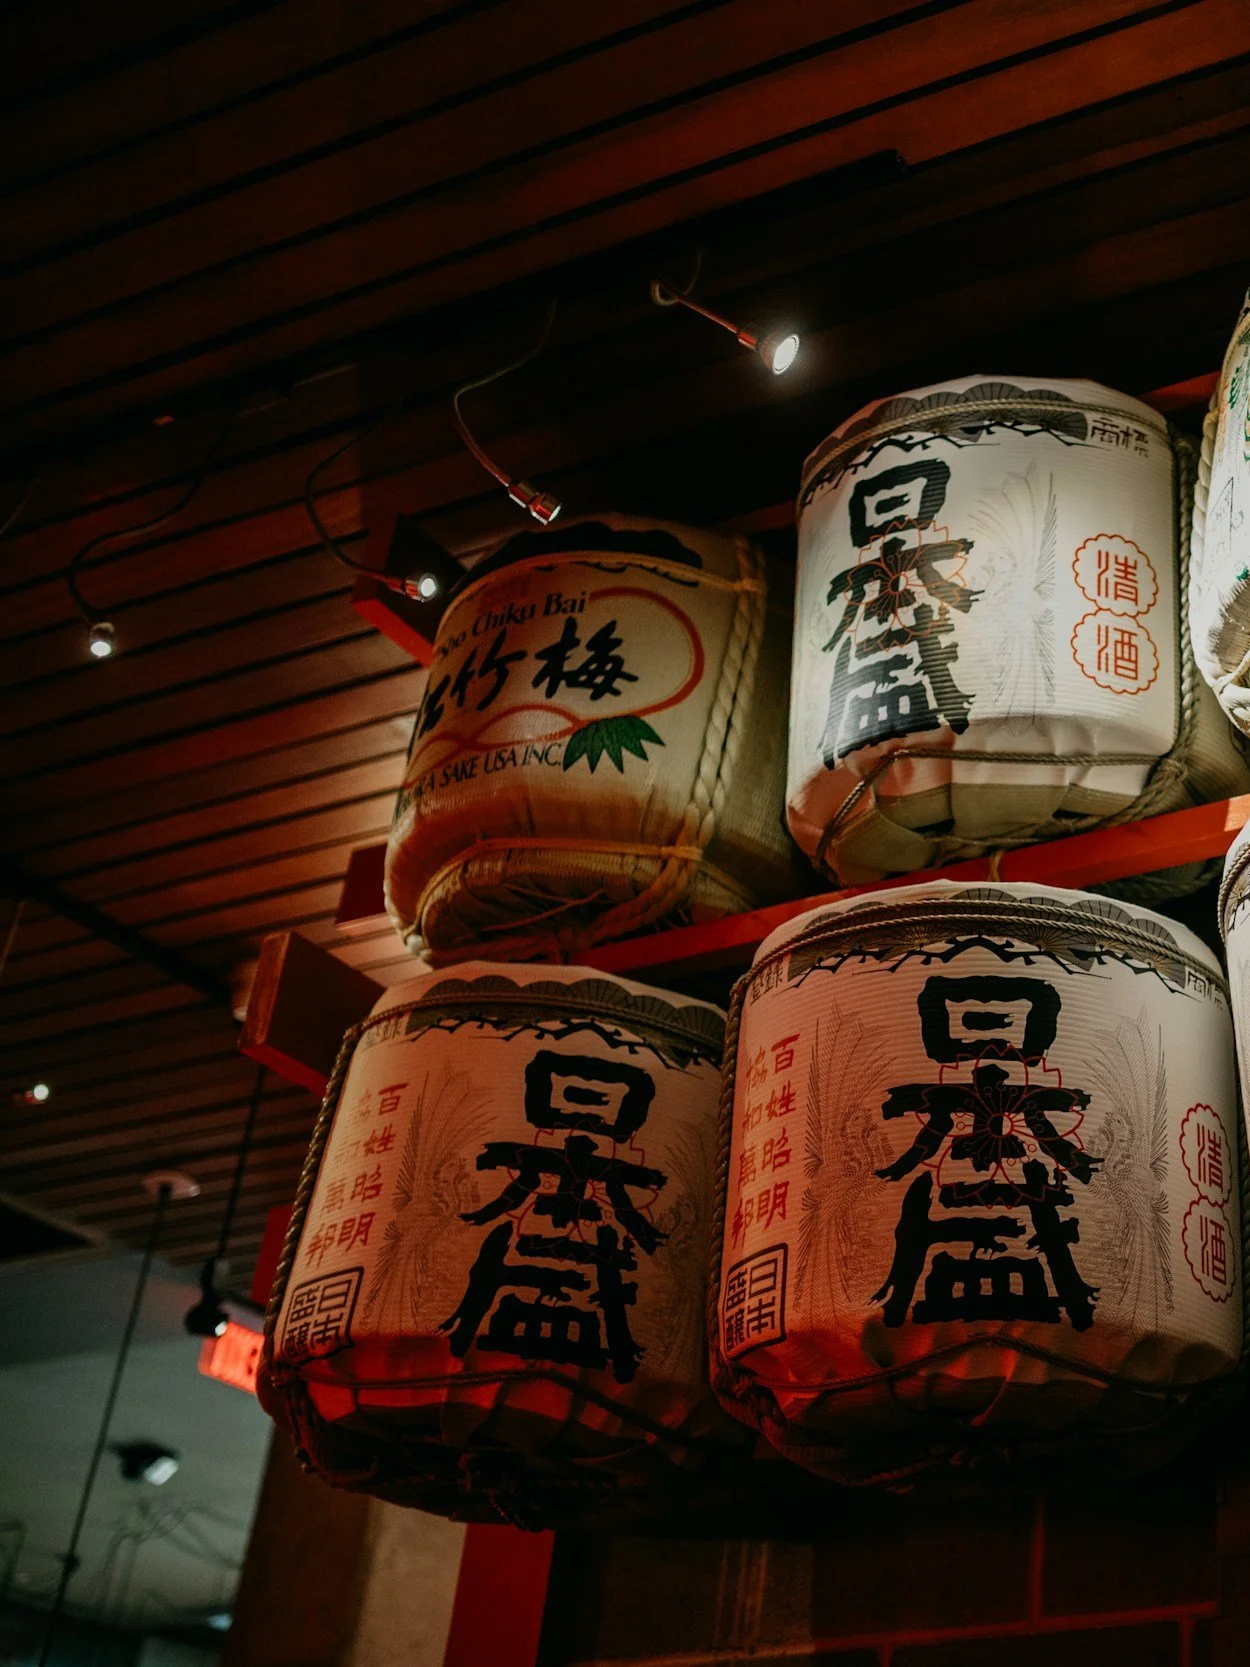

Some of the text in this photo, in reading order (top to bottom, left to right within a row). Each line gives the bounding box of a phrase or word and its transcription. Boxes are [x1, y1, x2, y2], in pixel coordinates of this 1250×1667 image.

[439, 755, 479, 787] SAKE
[484, 748, 517, 773] USA
[522, 743, 562, 767] INC.
[471, 602, 536, 636] Chiku
[543, 591, 587, 616] Bai
[818, 457, 985, 770] 日本盛
[435, 1049, 671, 1385] 日本盛
[868, 974, 1105, 1332] 日本盛
